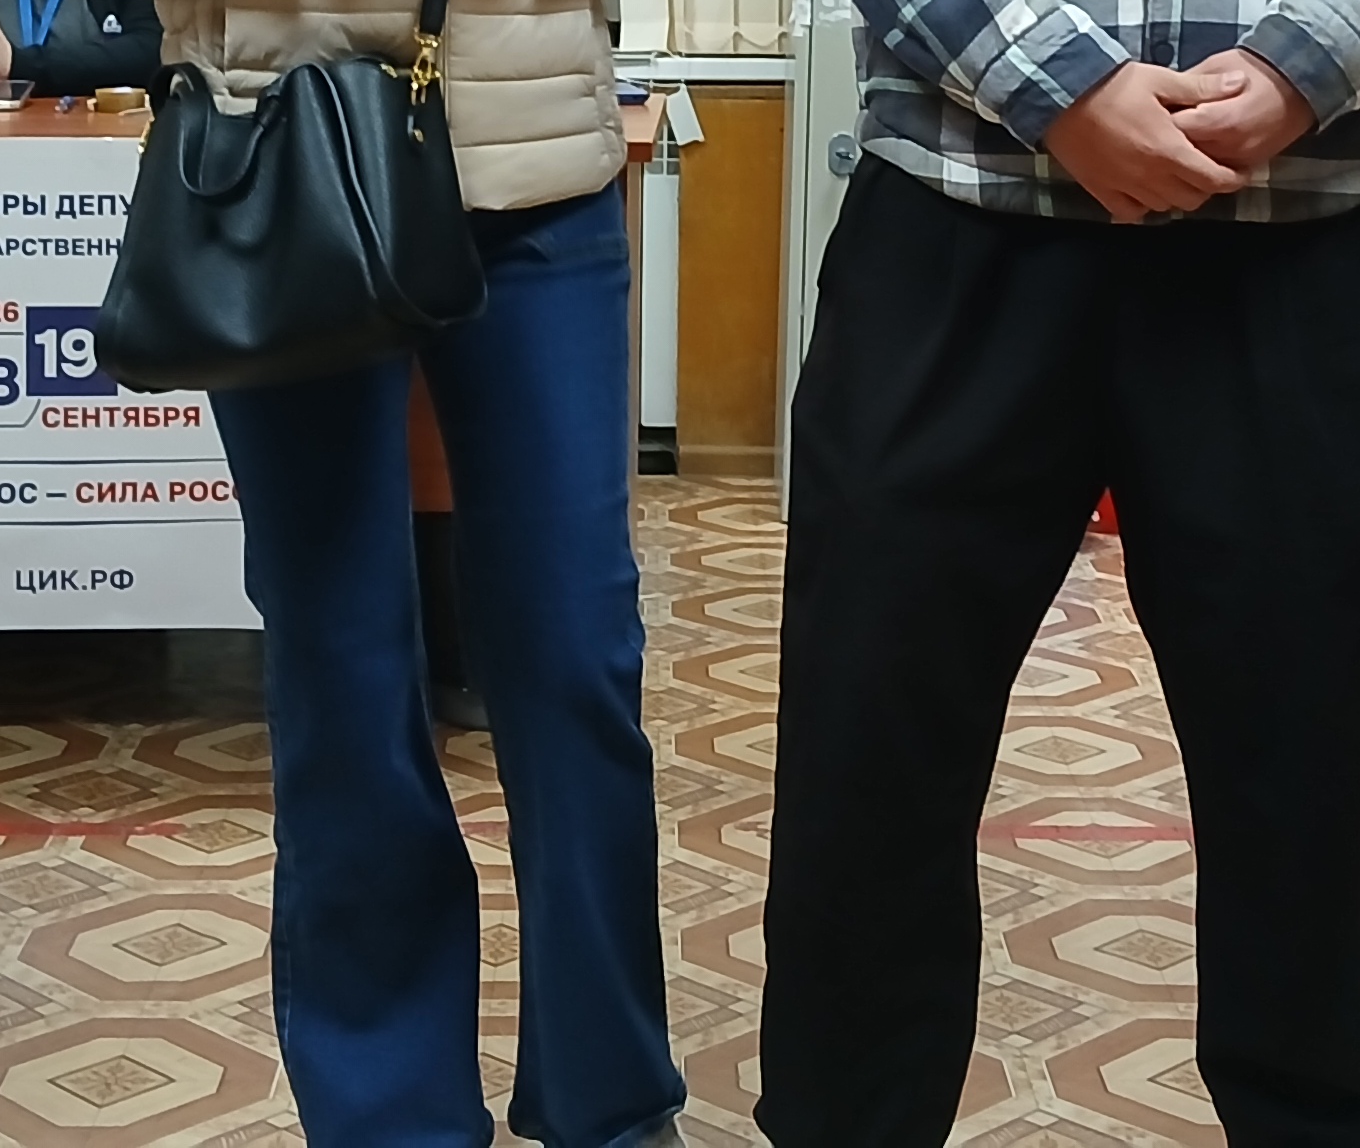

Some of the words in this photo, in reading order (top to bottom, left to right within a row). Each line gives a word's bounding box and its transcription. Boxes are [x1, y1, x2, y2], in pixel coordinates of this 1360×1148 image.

[34, 327, 98, 379] 19
[41, 405, 202, 429] СЕНТЯБРЯ
[75, 481, 160, 504] СИЛА
[15, 568, 135, 592] ЦИК.РФ
